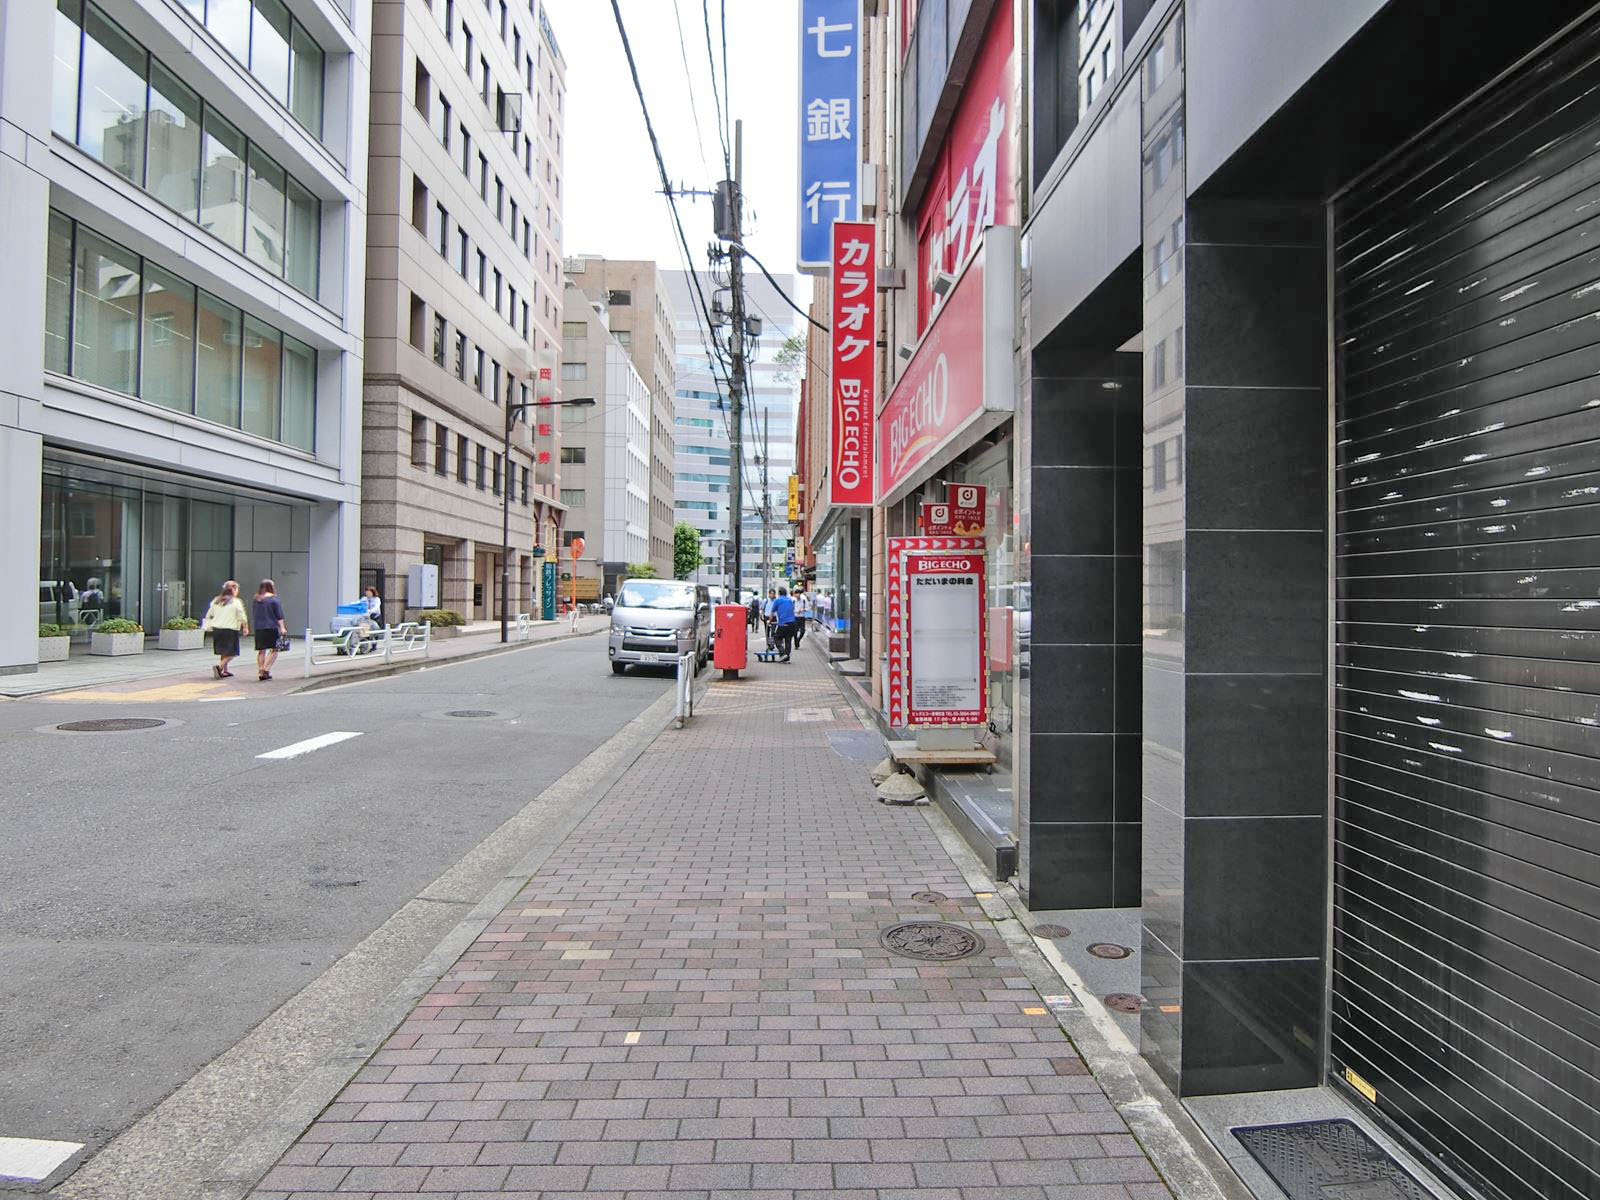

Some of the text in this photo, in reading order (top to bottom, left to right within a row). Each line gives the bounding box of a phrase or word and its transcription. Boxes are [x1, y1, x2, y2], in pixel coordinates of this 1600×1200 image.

[806, 17, 853, 224] 七銀行
[837, 239, 870, 363] カラオケ
[839, 378, 861, 490] BIG ECHO
[862, 388, 870, 478] Karaoke Entertainment
[890, 405, 909, 478] BIG
[909, 352, 949, 436] ECHO
[916, 577, 974, 586] ただいまの料金
[918, 559, 971, 571] BIG ECHO
